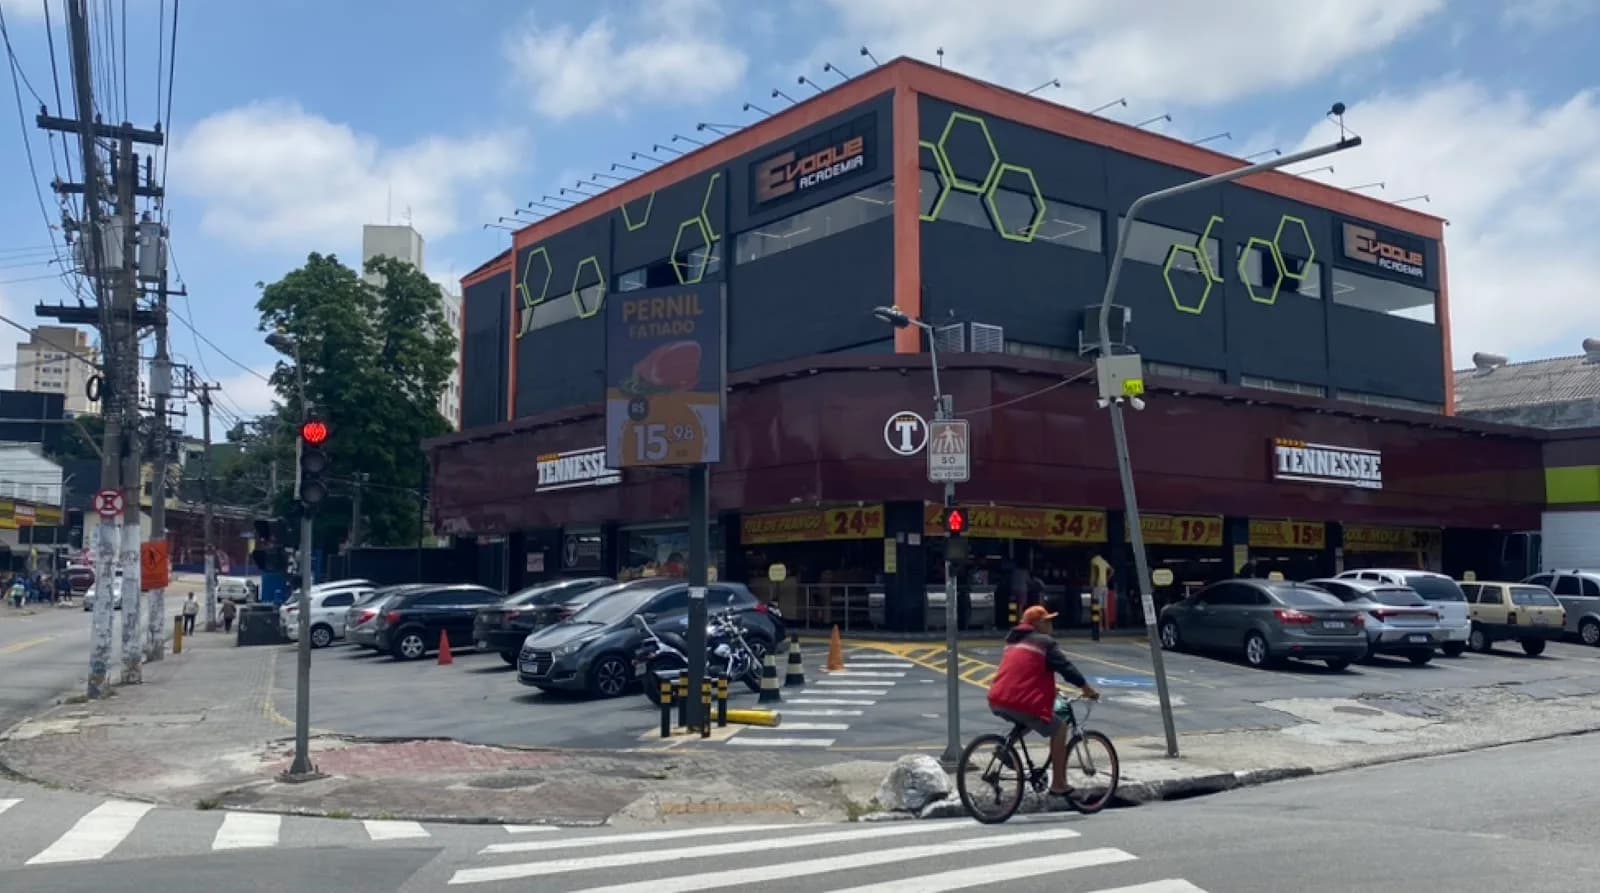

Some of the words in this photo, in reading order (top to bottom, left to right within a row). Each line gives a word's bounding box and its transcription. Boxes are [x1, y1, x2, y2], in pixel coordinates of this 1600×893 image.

[798, 155, 864, 190] ACADEMIA
[1378, 257, 1424, 278] ACADEMIA
[622, 294, 705, 321] PERNIL
[629, 319, 696, 339] FATIADO
[536, 451, 622, 486] TENNESSE
[1274, 446, 1382, 481] TENNESSEE
